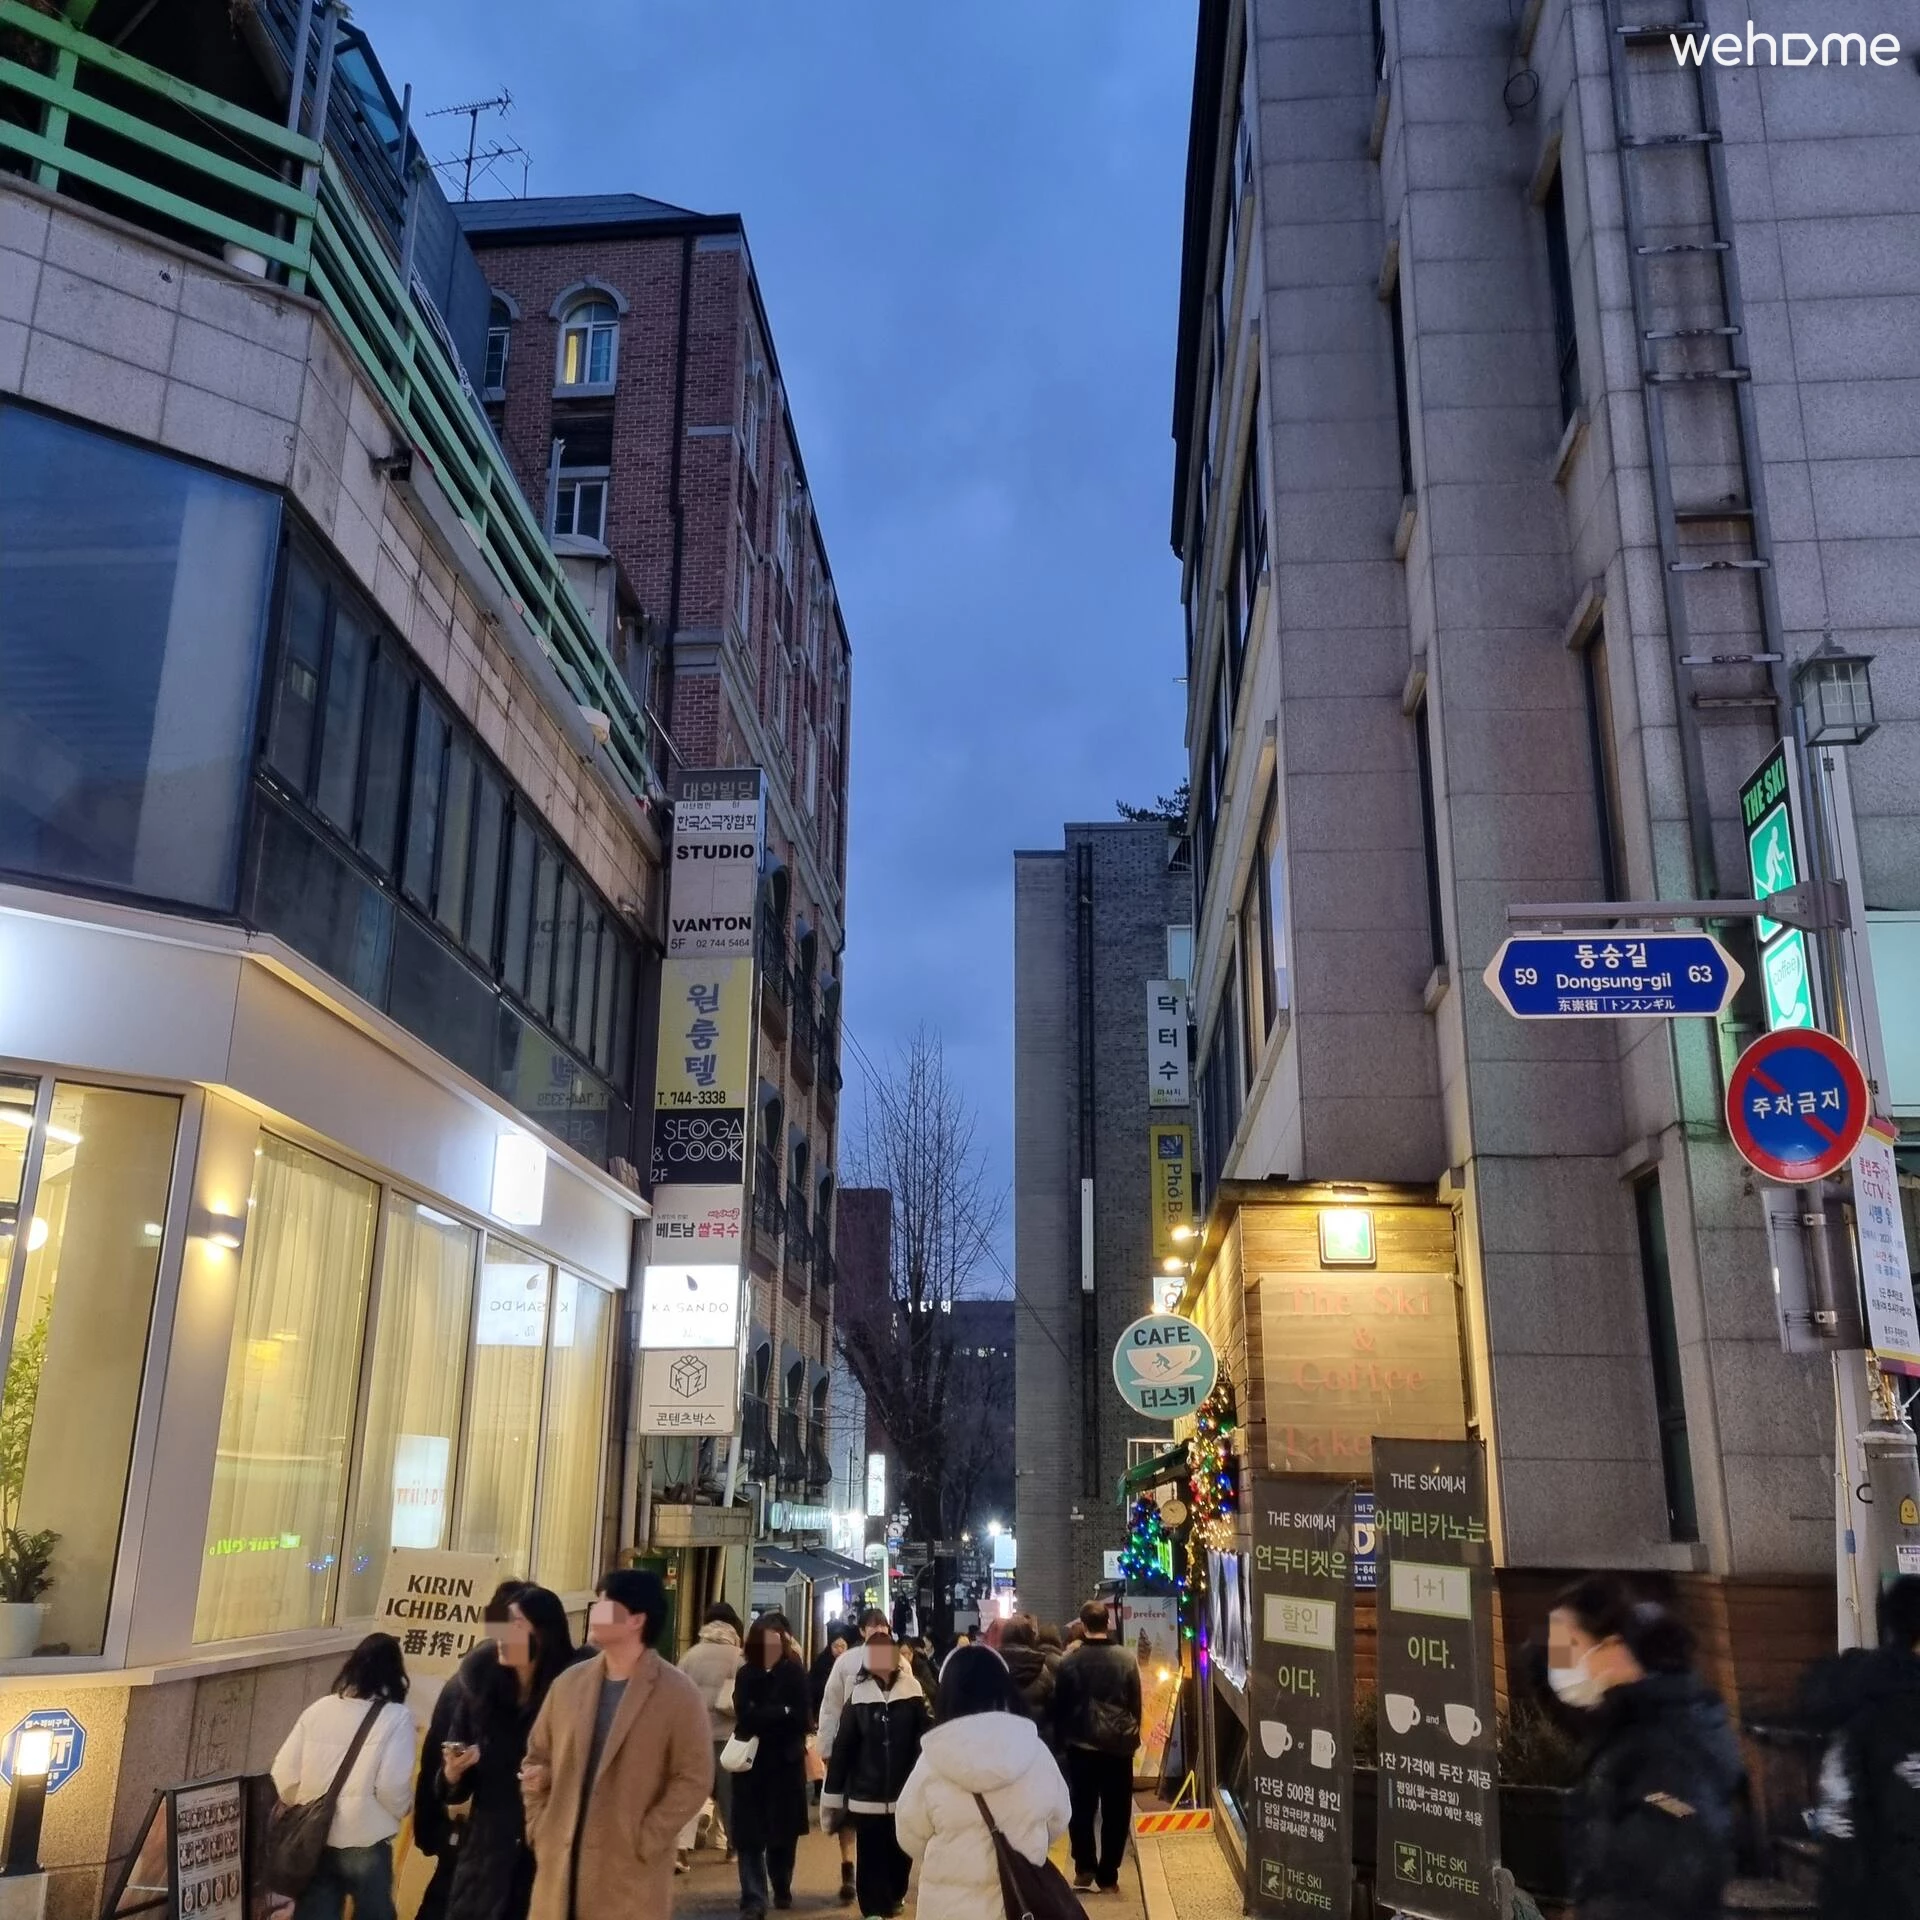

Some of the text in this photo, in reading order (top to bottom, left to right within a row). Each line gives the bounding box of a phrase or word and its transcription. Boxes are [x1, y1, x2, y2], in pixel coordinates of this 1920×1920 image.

[1743, 756, 1786, 826] THE SKI
[677, 814, 757, 831] 한국소극장협회
[676, 844, 754, 860] STUDIO
[672, 917, 751, 933] VANTON
[671, 938, 686, 950] 5F
[696, 939, 707, 948] 02
[710, 938, 726, 948] 744
[1574, 942, 1648, 969] 동숭길
[1514, 968, 1538, 986] 59
[1556, 973, 1672, 991] Dongsung-gil
[1688, 966, 1713, 983] 63
[1611, 999, 1676, 1011] トンスンギル
[685, 983, 719, 1087] 원룸텔
[1157, 995, 1179, 1081] 닥터수
[671, 1091, 726, 1105] 744-3338
[1752, 1087, 1840, 1120] 주차금지
[664, 1118, 744, 1140] SEOGA
[653, 1140, 743, 1161] & COOK
[651, 1168, 668, 1182] 2F
[1862, 1179, 1884, 1199] CCTV
[655, 1222, 740, 1239] 베트남 쌀국수
[1374, 1285, 1432, 1317] Ski
[1134, 1326, 1191, 1346] CAFE
[1354, 1327, 1376, 1350] &
[1292, 1361, 1428, 1392] Coffee
[1140, 1387, 1195, 1408] 더스키
[656, 1412, 716, 1426] 콘텐츠박스
[1390, 1473, 1466, 1494] THE SKI에서
[1267, 1510, 1335, 1532] THE SKI에서
[1375, 1510, 1486, 1543] 아메리카노는
[1255, 1544, 1347, 1579] 연극티켓은
[407, 1574, 473, 1598] KIRIN
[1413, 1574, 1446, 1602] 1+1
[385, 1598, 482, 1624] ICHIBAN
[1281, 1604, 1319, 1634] 할인
[1408, 1636, 1455, 1669] 이다.
[1278, 1666, 1320, 1698] 이다.
[1425, 1714, 1440, 1725] and
[1379, 1752, 1492, 1790] 1잔 가격에 두잔 제공
[1254, 1776, 1341, 1812] 1잔당 500원 할인
[1264, 1802, 1280, 1817] 당일
[1465, 1810, 1483, 1827] 적용
[1425, 1846, 1446, 1869] THE
[1449, 1857, 1467, 1873] SKI
[1287, 1868, 1305, 1885] THE
[1307, 1874, 1322, 1890] SKI
[1426, 1869, 1480, 1896] & COFFEE
[1286, 1886, 1332, 1911] & COFFEE
